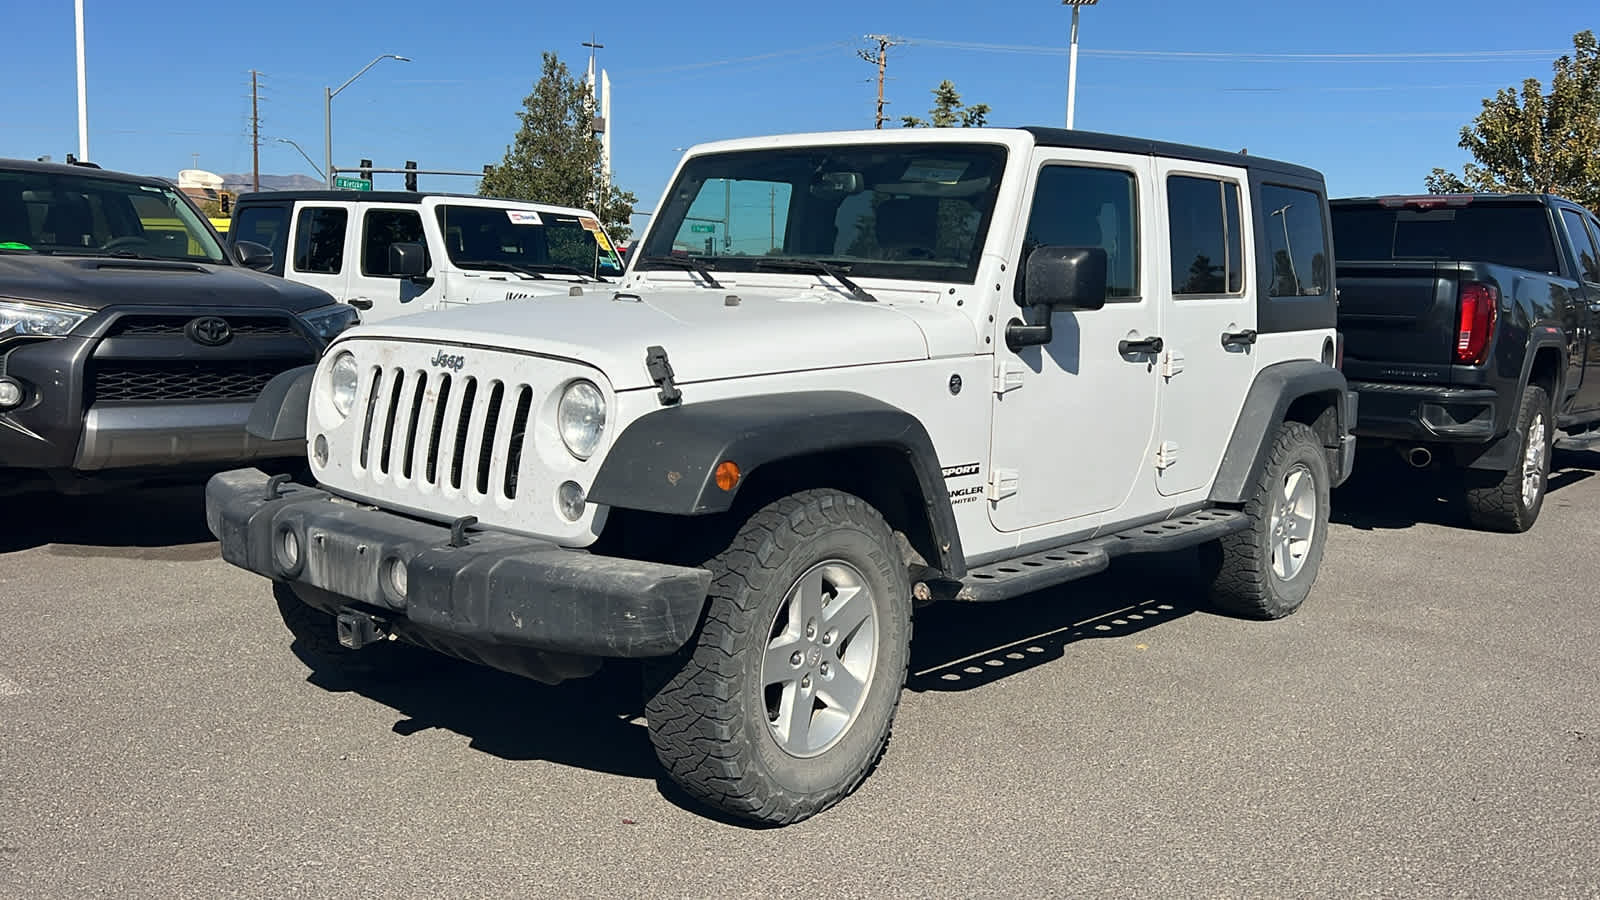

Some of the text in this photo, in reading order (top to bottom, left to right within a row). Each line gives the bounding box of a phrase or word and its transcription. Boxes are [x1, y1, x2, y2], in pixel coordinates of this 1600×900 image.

[431, 349, 464, 373] Jeep
[942, 464, 979, 477] SPORT
[951, 496, 977, 505] IMITED
